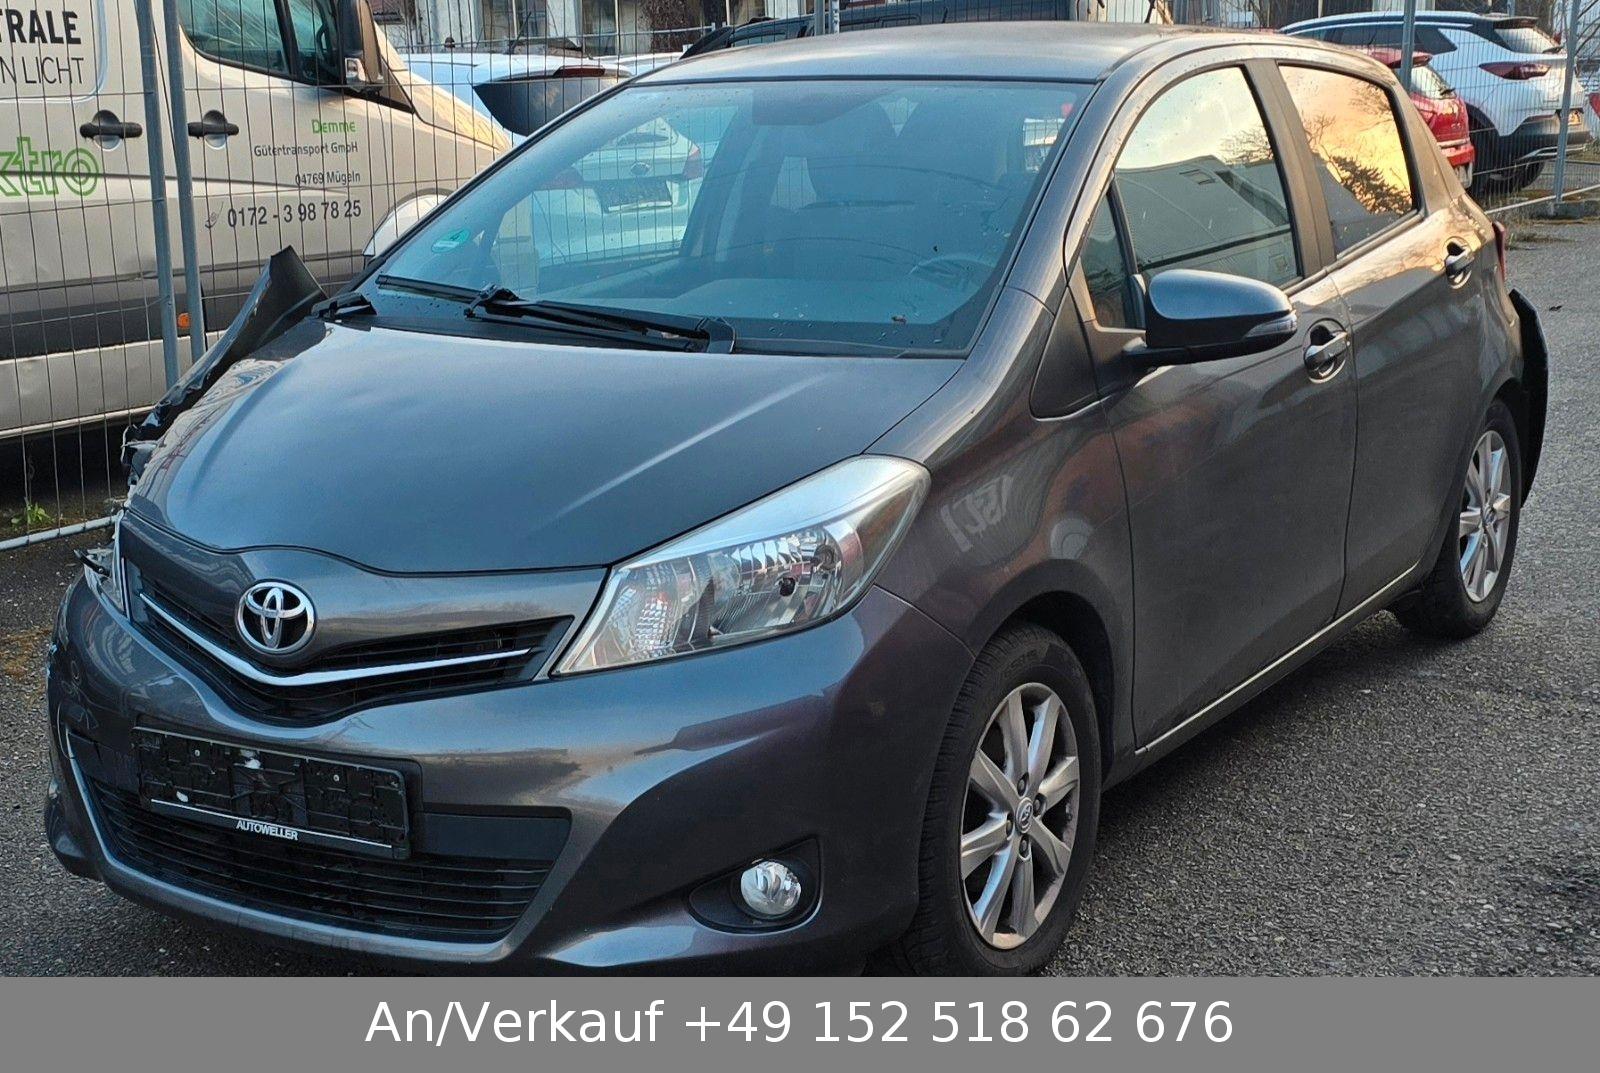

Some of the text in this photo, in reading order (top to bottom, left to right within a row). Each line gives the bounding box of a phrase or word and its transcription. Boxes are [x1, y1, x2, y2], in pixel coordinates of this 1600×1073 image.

[22, 56, 84, 84] LICHT
[312, 119, 356, 134] Demme
[254, 144, 329, 157] Gütertransport
[295, 170, 361, 185] 04769 Mügeln
[228, 206, 267, 227] 0172
[284, 204, 293, 223] 3
[297, 203, 317, 222] 98
[321, 201, 340, 220] 78
[344, 199, 361, 218] 25
[236, 819, 298, 841] AUTOWELLER
